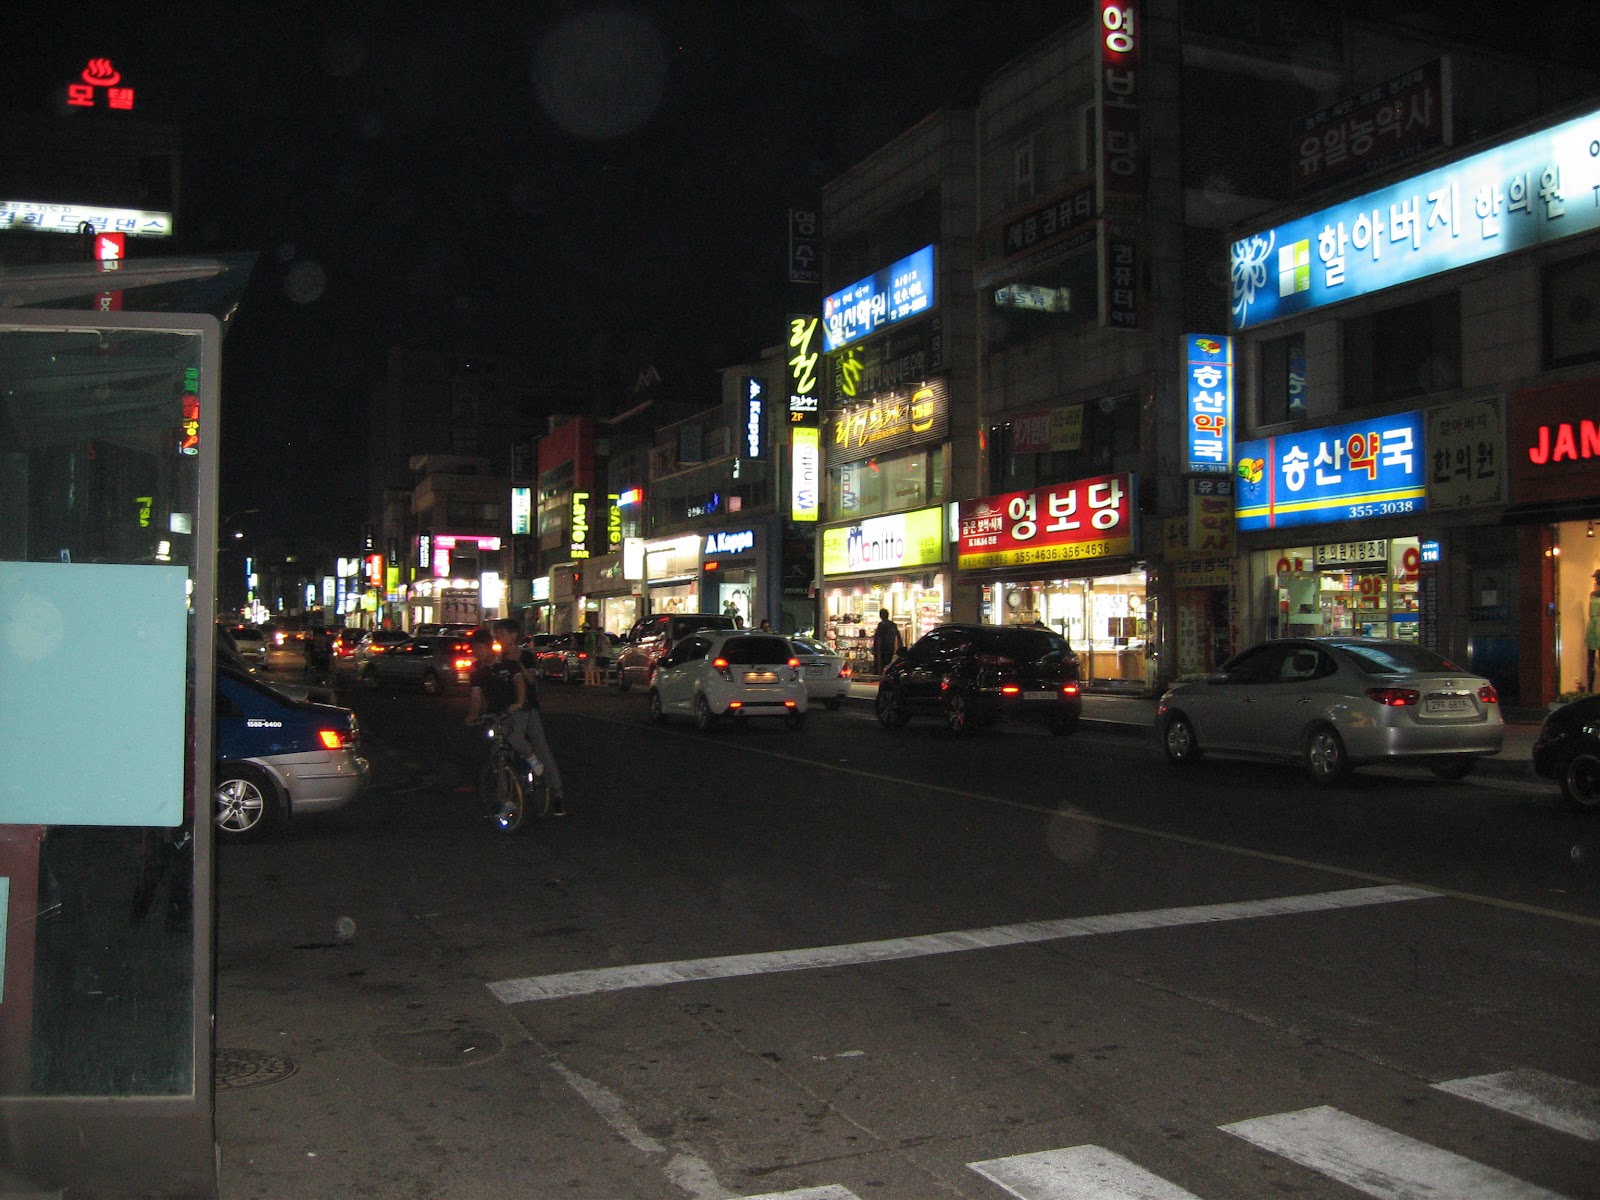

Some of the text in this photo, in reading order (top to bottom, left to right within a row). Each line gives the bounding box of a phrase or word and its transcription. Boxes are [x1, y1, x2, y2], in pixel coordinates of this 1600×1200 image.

[67, 83, 135, 110] 모텔
[1318, 164, 1565, 288] 할아버지 한의원
[790, 412, 804, 422] 2F
[1193, 365, 1226, 463] 송산약국
[1282, 427, 1415, 493] 송산약국
[1433, 442, 1496, 484] 한의원
[1008, 479, 1125, 541] 영보당
[1348, 500, 1414, 519] 355-3038
[718, 530, 754, 554] Kappa
[848, 526, 904, 569] Manitto
[1422, 551, 1438, 562] 114
